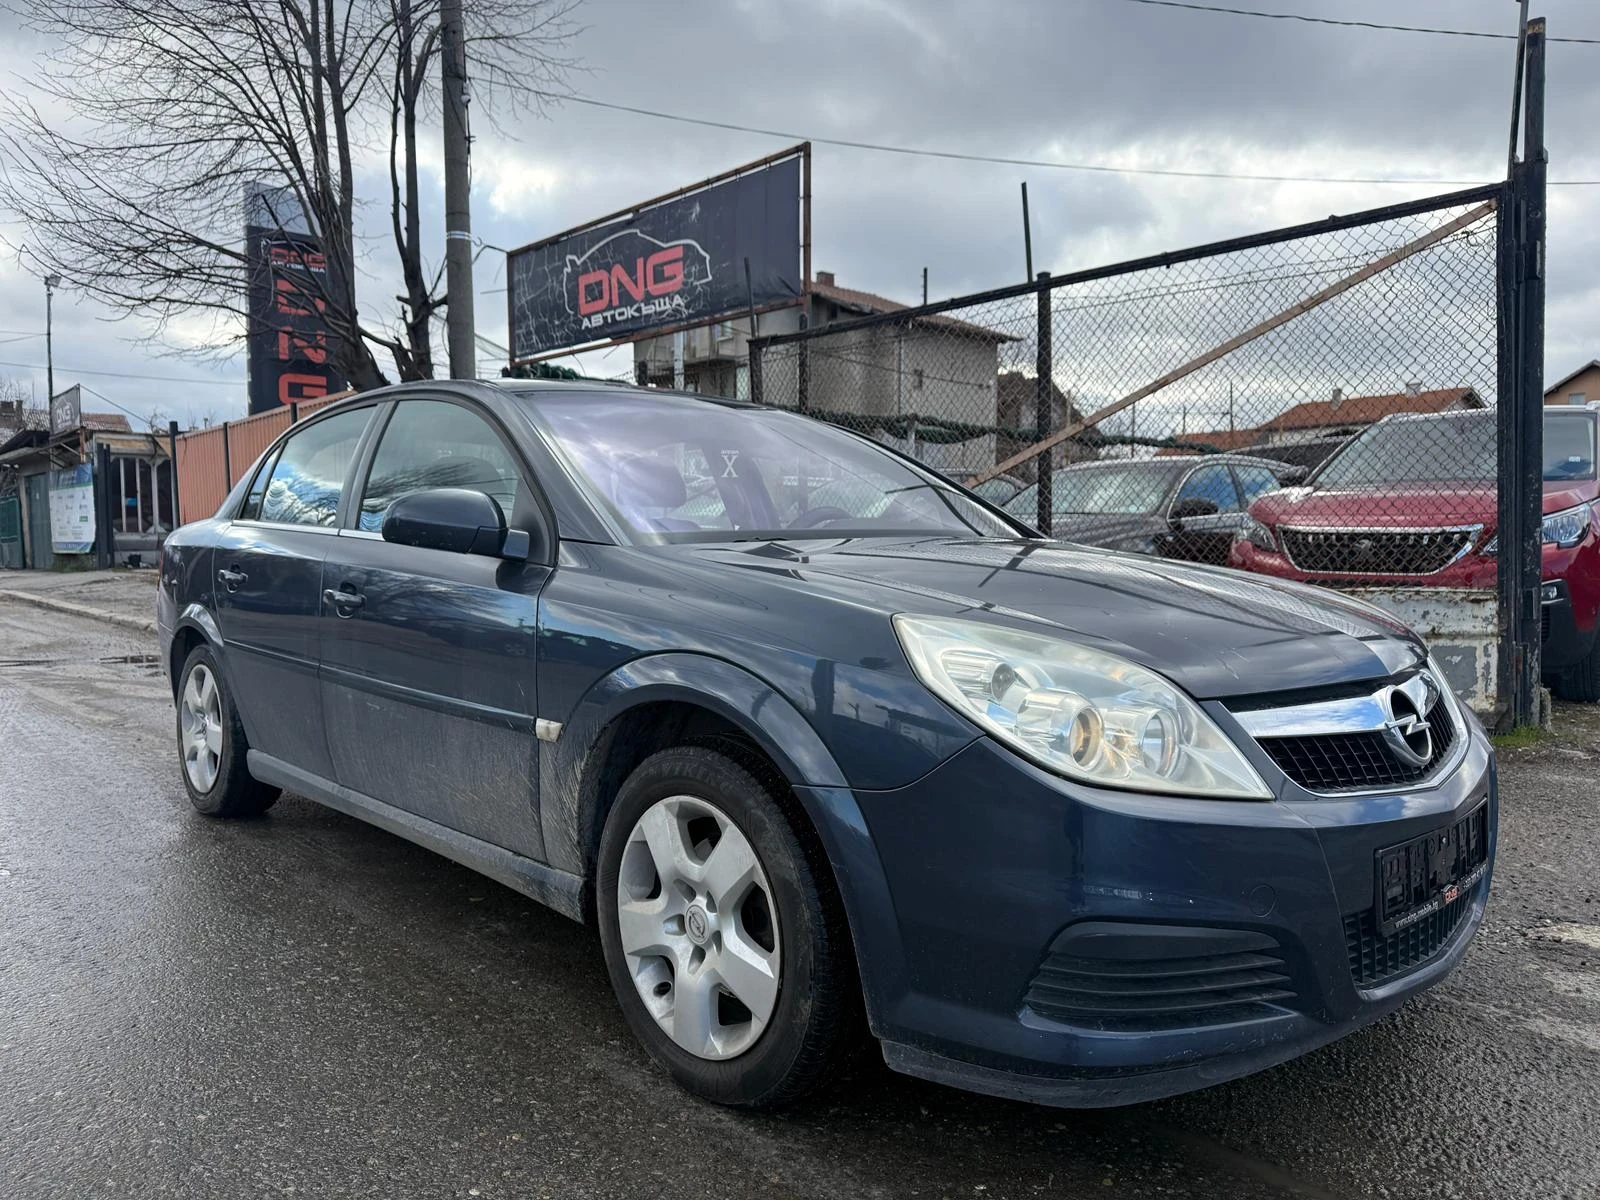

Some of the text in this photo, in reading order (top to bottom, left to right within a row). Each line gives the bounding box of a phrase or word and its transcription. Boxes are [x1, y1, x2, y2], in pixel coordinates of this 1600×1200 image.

[271, 247, 325, 268] DNG
[578, 245, 684, 316] DNG
[582, 294, 684, 330] АВТОКЪЩА
